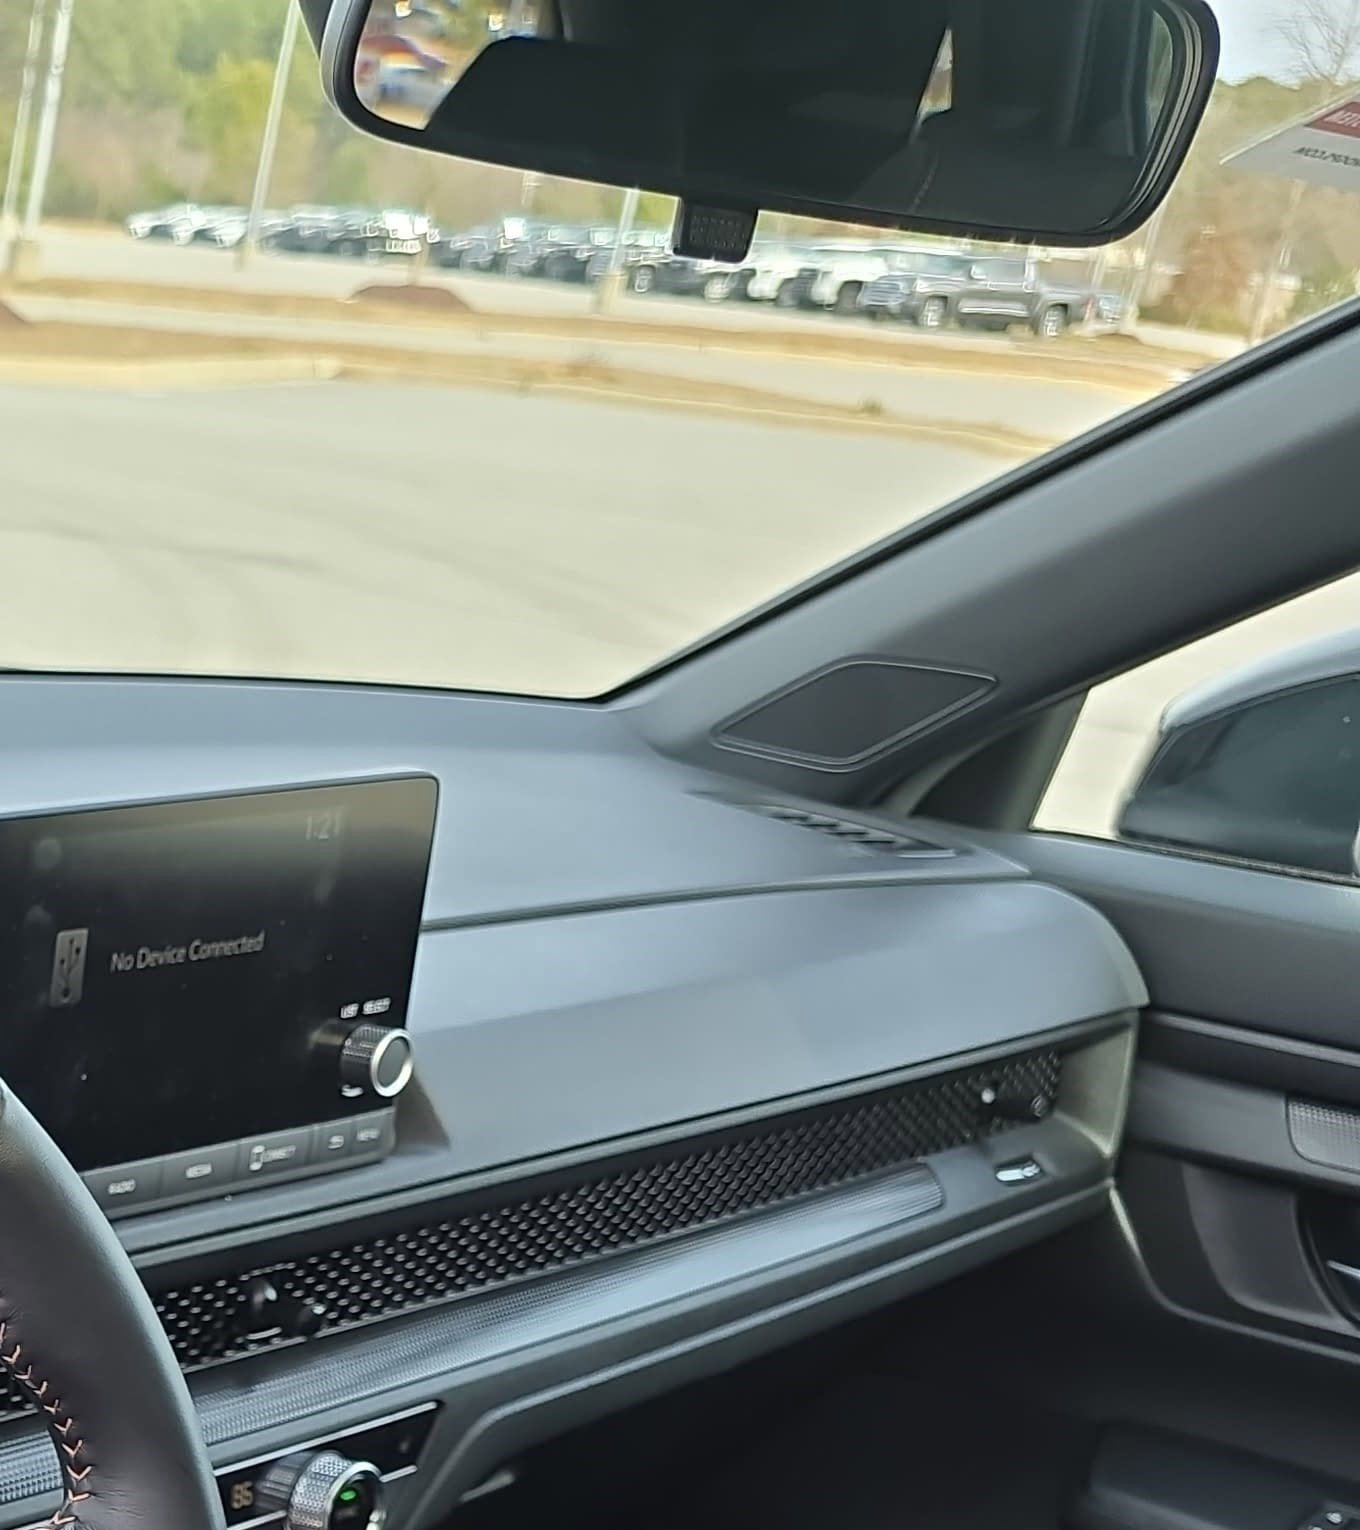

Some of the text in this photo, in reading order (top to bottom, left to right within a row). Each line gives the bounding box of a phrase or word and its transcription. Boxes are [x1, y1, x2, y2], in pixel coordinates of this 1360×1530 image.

[109, 930, 266, 973] No Device Connected
